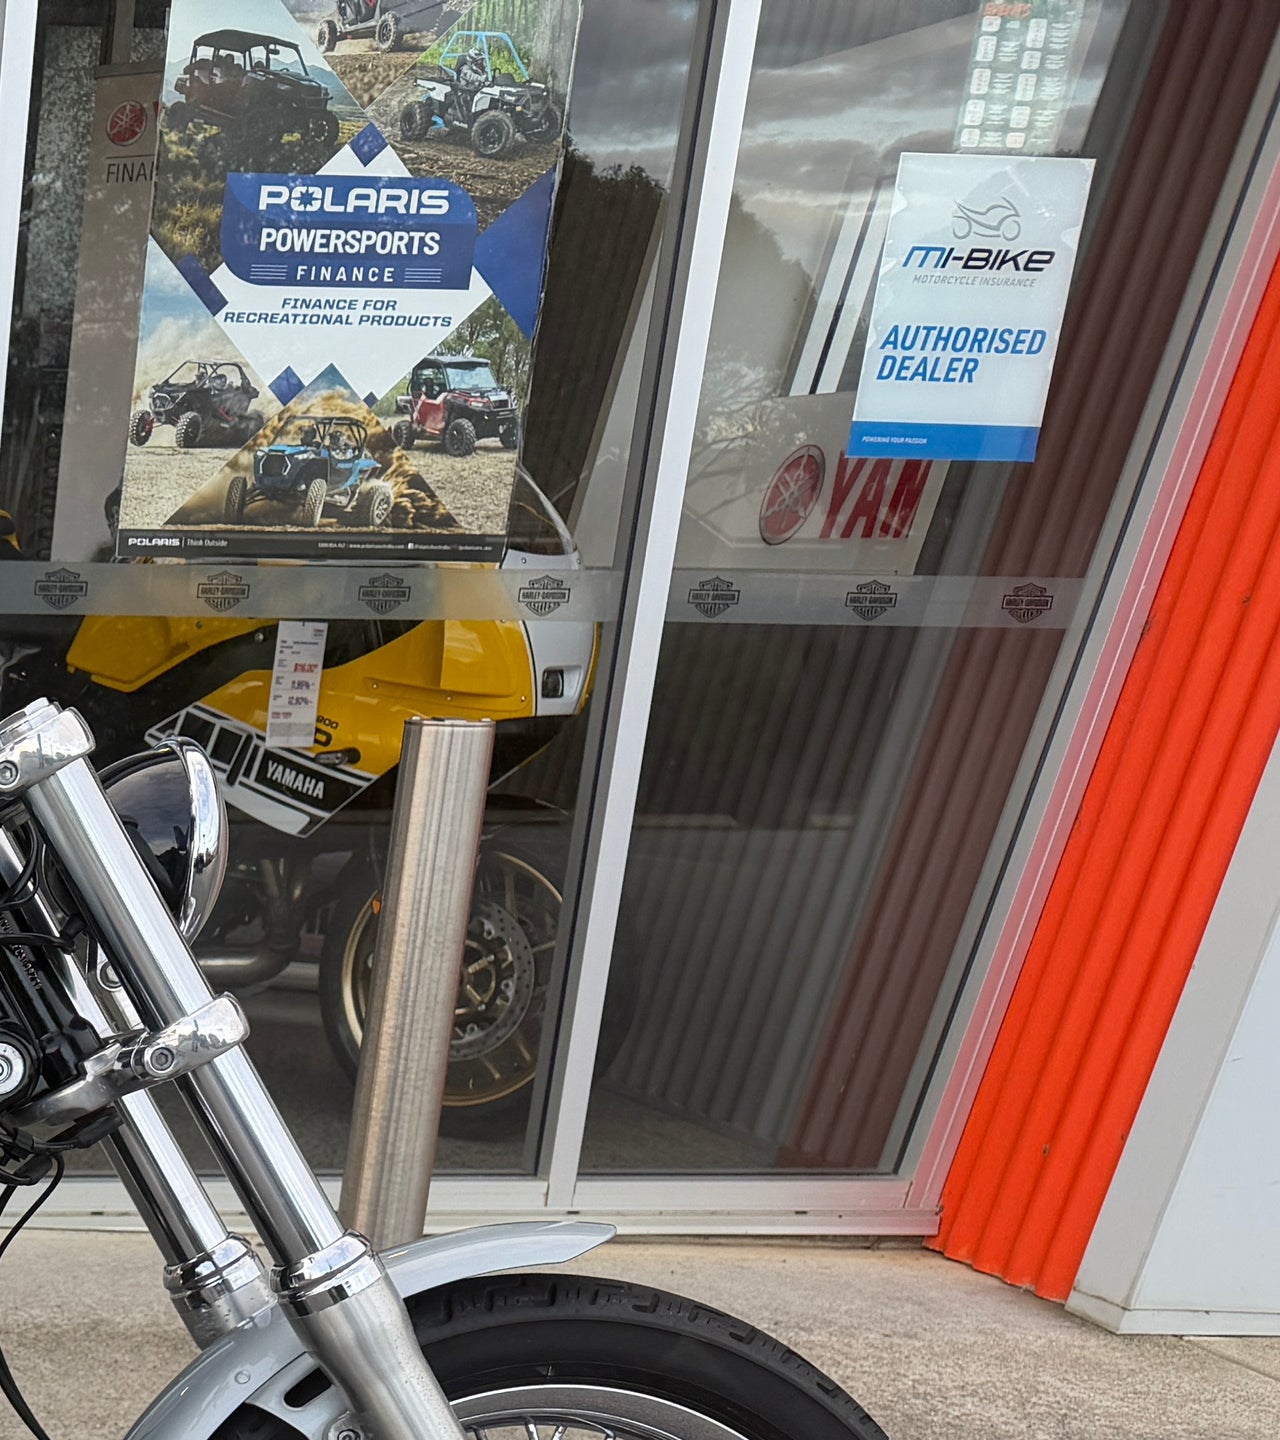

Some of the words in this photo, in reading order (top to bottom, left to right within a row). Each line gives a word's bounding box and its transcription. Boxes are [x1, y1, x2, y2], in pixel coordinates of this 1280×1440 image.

[259, 185, 450, 215] POLARIS
[259, 227, 441, 255] POWERSPORTS
[296, 266, 395, 282] FINANCE
[913, 274, 978, 286] MOTORCYCLE
[979, 278, 1037, 288] INSURANCE
[282, 298, 358, 311] FINANCE
[362, 299, 397, 311] FOR
[223, 312, 354, 326] RECREATIONAL
[358, 315, 452, 327] PRODUCTS
[880, 324, 1047, 355] AUTHORISED
[876, 355, 979, 383] DEALER
[890, 436, 905, 444] YOUR
[128, 537, 180, 546] POLARIS
[266, 760, 326, 799] YAMAHA
